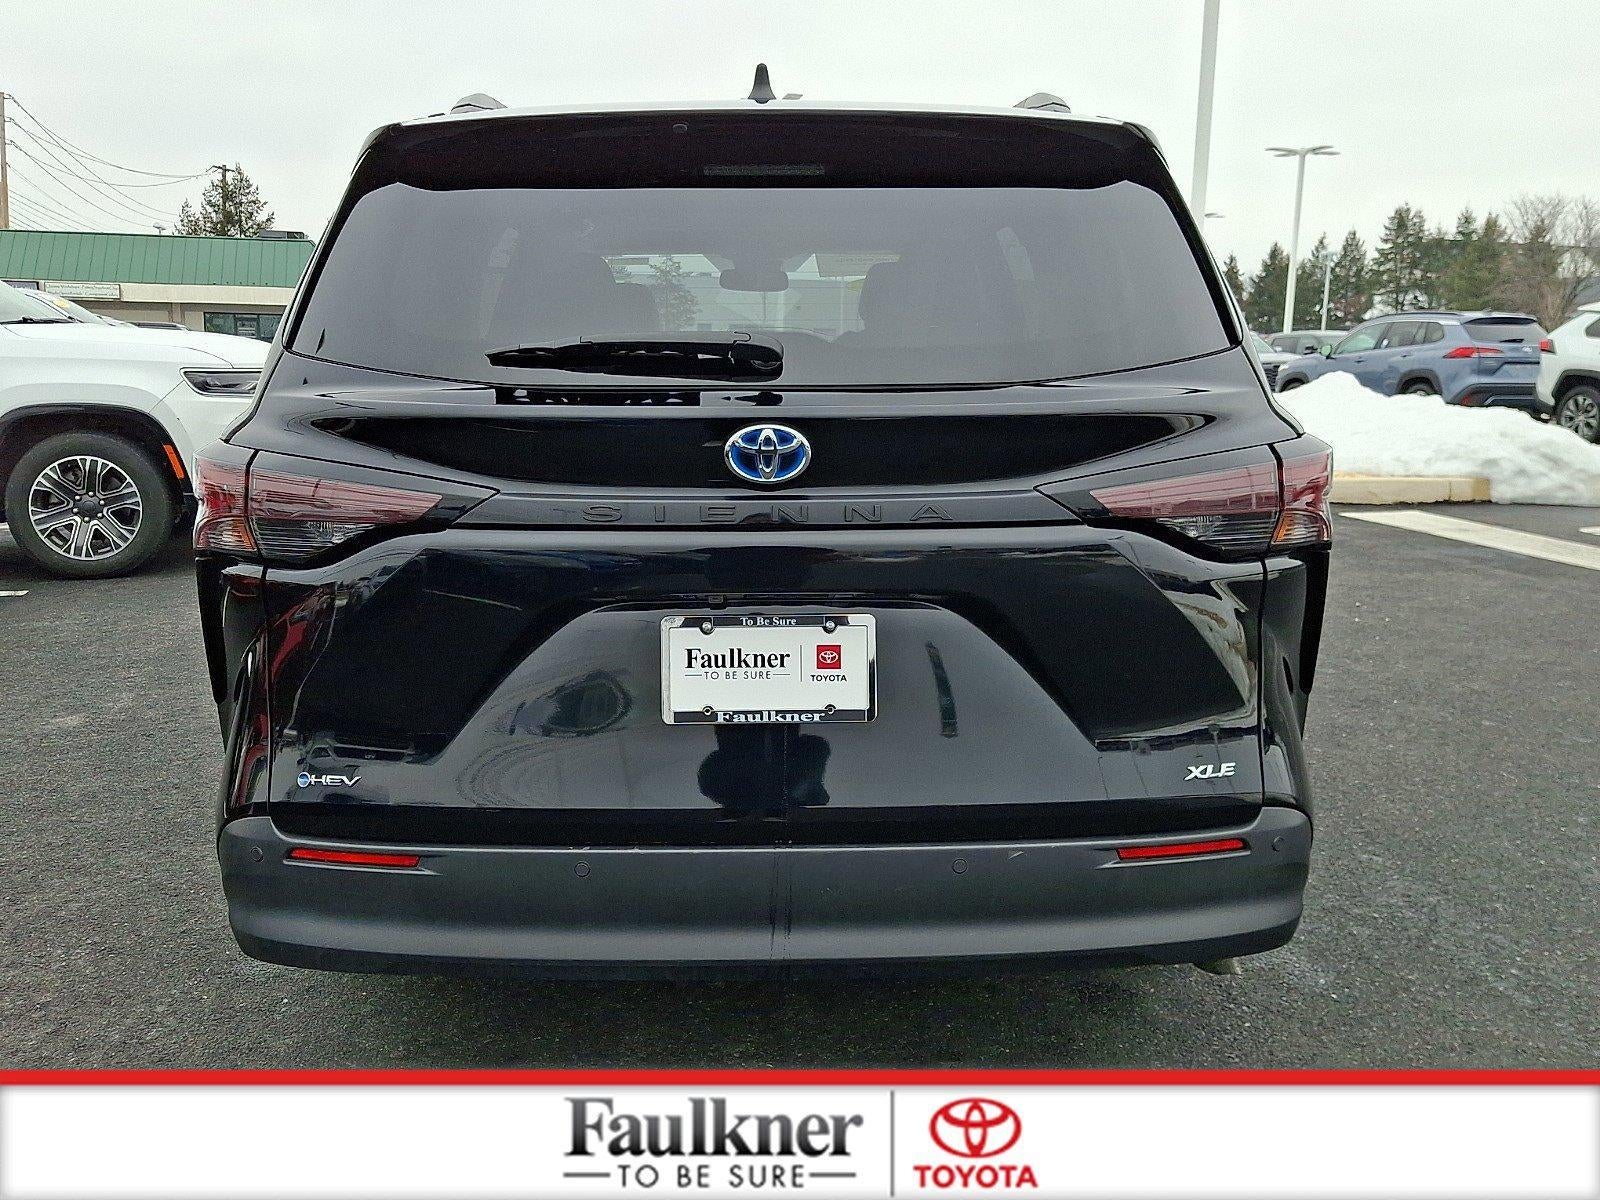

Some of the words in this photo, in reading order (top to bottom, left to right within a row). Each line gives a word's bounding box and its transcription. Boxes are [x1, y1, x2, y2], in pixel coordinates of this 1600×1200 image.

[582, 503, 953, 523] SIENNA
[740, 617, 753, 626] To
[756, 617, 770, 626] Be
[772, 617, 797, 626] Sure
[685, 648, 791, 669] Faulkner
[704, 671, 719, 680] TO
[725, 671, 738, 680] BE
[743, 671, 771, 680] SURE
[810, 674, 847, 682] TOYOTA
[715, 711, 826, 723] Faulkner
[1183, 762, 1236, 780] XLE
